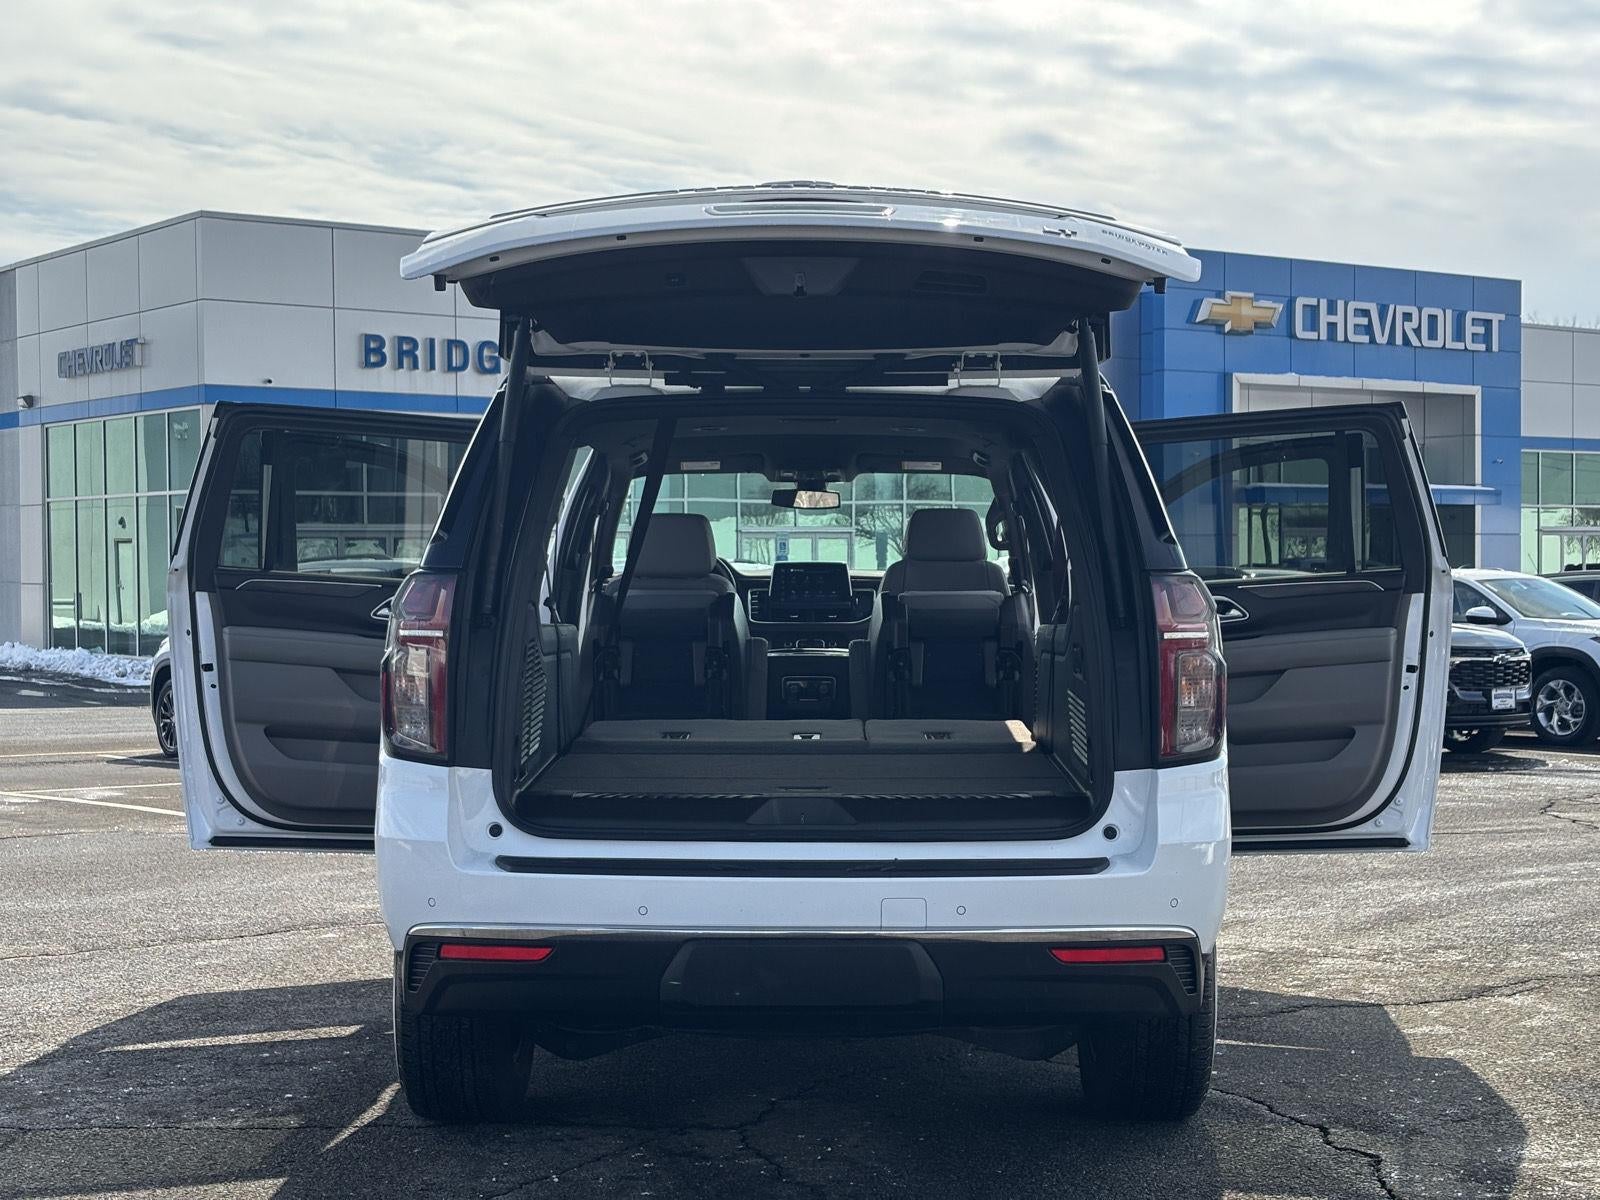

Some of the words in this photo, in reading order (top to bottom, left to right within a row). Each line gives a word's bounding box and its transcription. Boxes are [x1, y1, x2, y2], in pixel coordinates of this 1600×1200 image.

[1295, 296, 1505, 352] CHEVROLET
[57, 337, 145, 379] CHEVROLET
[361, 333, 501, 374] BRIDG
